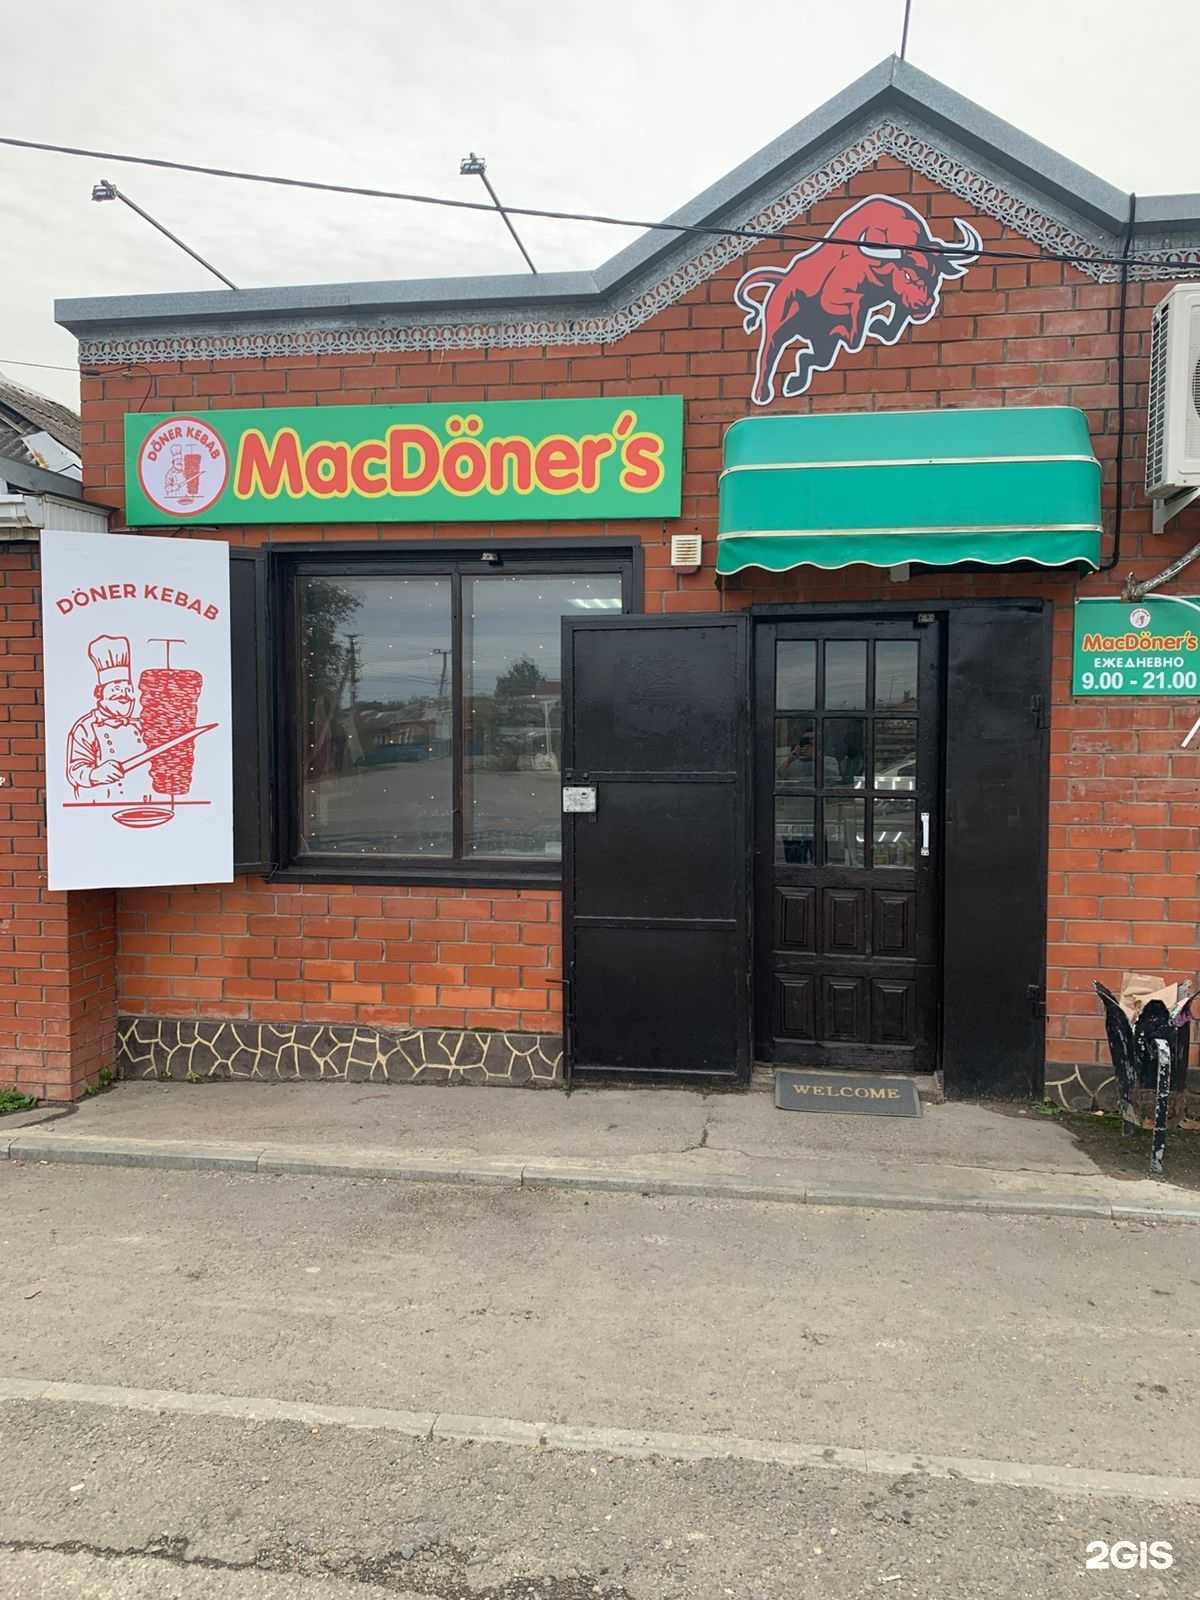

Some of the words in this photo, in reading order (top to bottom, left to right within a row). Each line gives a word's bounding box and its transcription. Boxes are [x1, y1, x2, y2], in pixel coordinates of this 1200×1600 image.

[147, 426, 183, 462] DÖNER
[186, 426, 220, 460] KEBAB
[56, 583, 137, 615] DÖNER
[144, 584, 219, 620] KEBAB
[1094, 656, 1184, 668] ЕЖЕДНЕВНО
[1082, 672, 1123, 690] 9.00
[1142, 671, 1197, 690] 21.00
[792, 1084, 900, 1099] WELCOME
